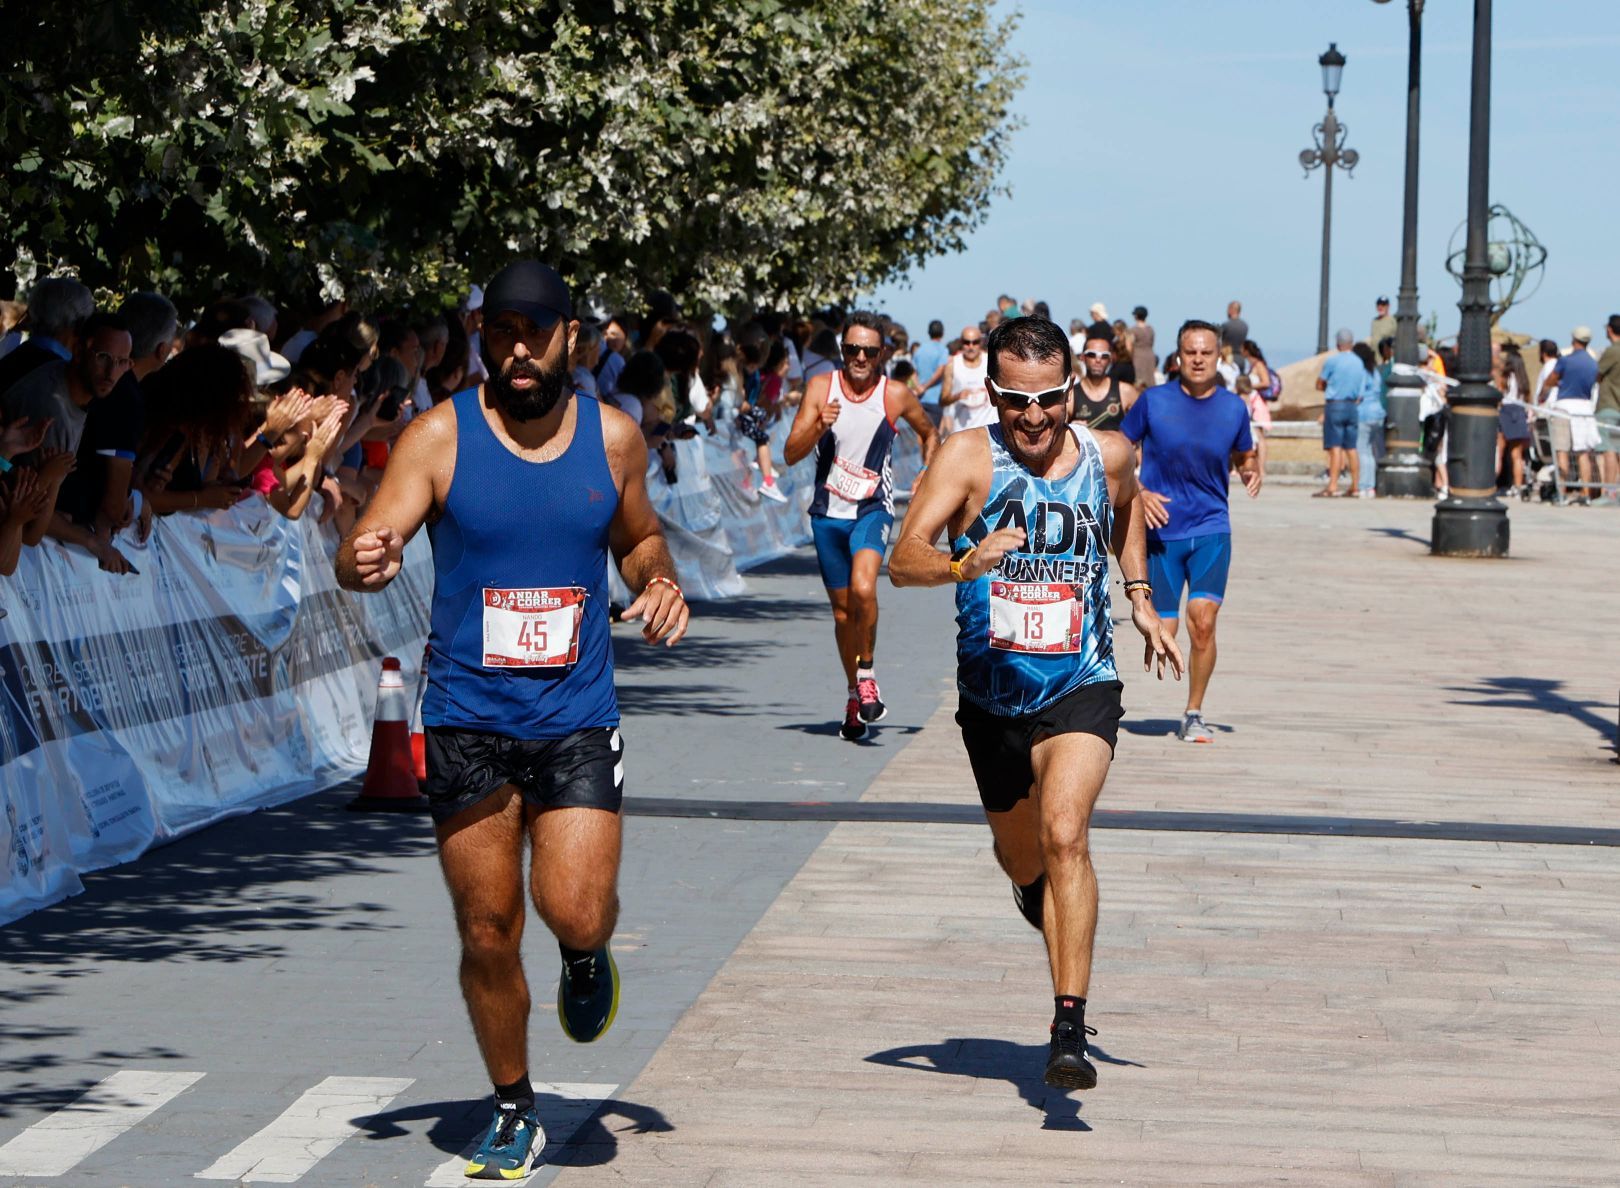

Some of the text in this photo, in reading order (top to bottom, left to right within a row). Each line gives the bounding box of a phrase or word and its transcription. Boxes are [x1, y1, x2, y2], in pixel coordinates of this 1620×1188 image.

[993, 499, 1110, 557] ADN
[1012, 585, 1049, 593] ANDAR
[508, 591, 549, 599] ANDAR
[1020, 591, 1060, 600] CORRER
[518, 597, 561, 606] CORRER
[1023, 611, 1044, 640] 13
[517, 620, 548, 652] 45
